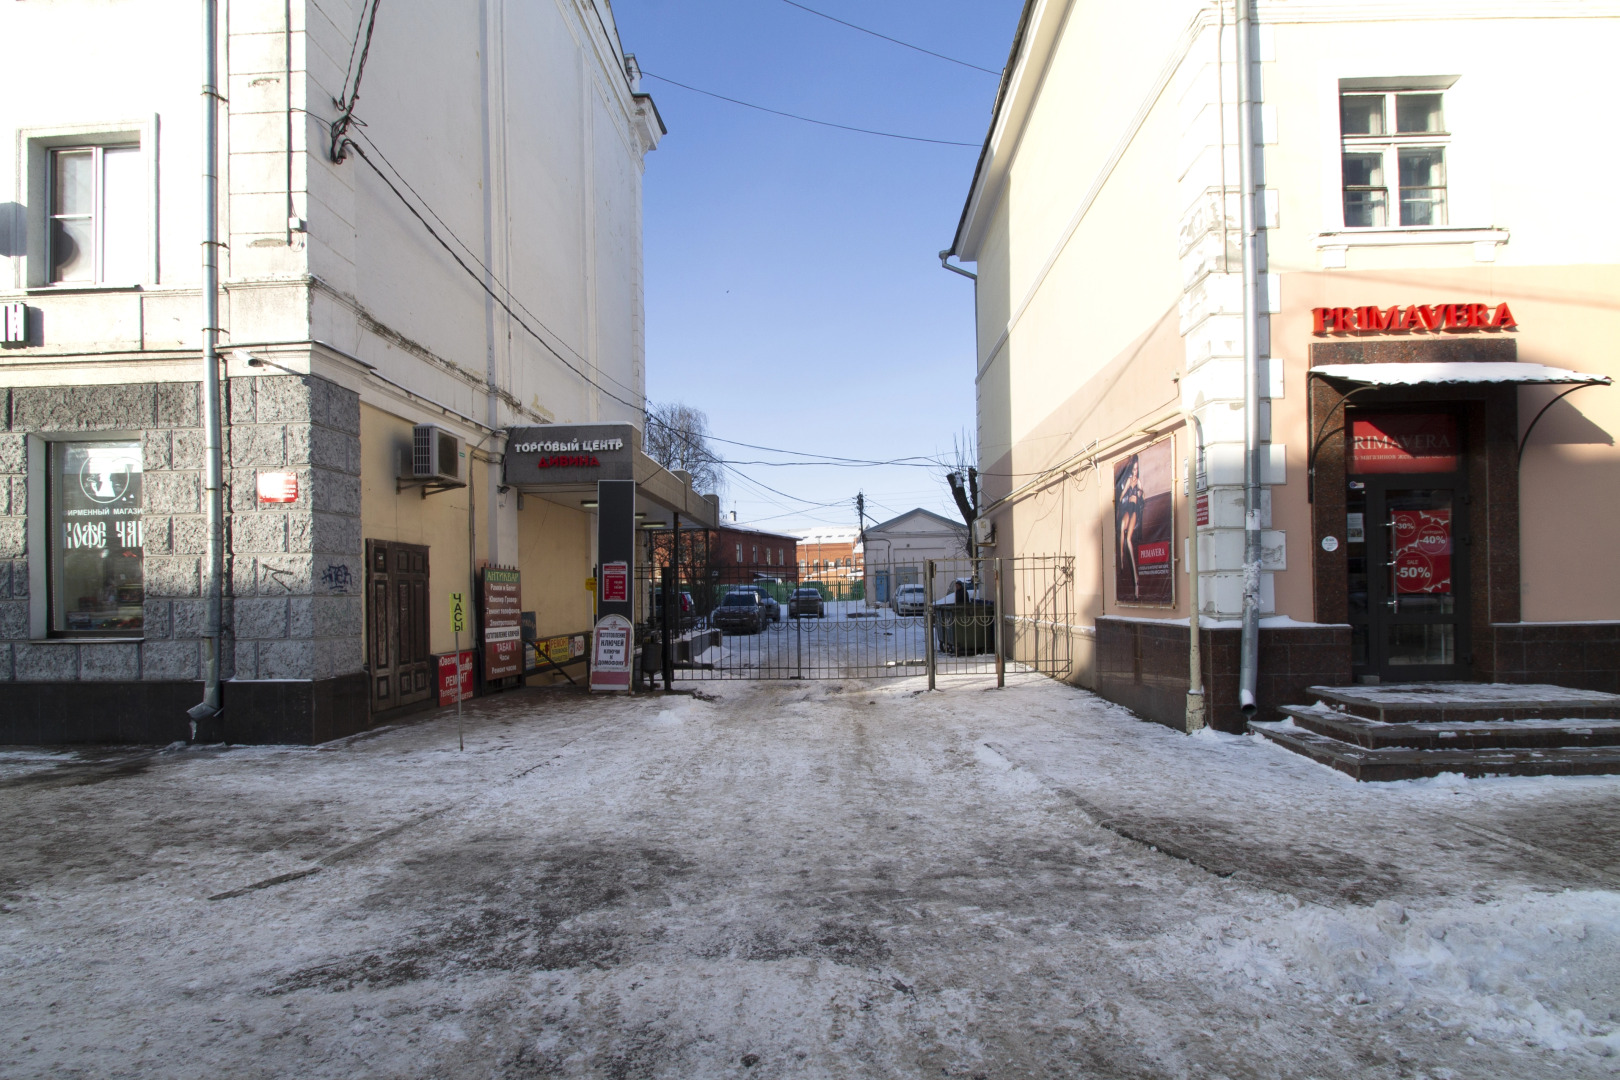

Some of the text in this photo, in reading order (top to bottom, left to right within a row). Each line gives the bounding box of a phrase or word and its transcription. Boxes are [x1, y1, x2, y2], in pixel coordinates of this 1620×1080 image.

[1311, 303, 1518, 335] PRIMAVERA
[515, 438, 623, 452] ТОРГОВЫЙ ЦЕНТР
[538, 456, 600, 468] ДИВИНА
[67, 508, 110, 516] ИРМЕННЫЙ
[1419, 536, 1446, 544] -40%
[1140, 548, 1166, 559] PRIMAVERA
[487, 571, 519, 582] АНТИКВАР
[1396, 566, 1431, 578] -50%
[453, 593, 463, 631] ЧАСЫ
[601, 639, 624, 647] КЛЮЧЕЙ
[445, 672, 468, 687] РЕМНТ
